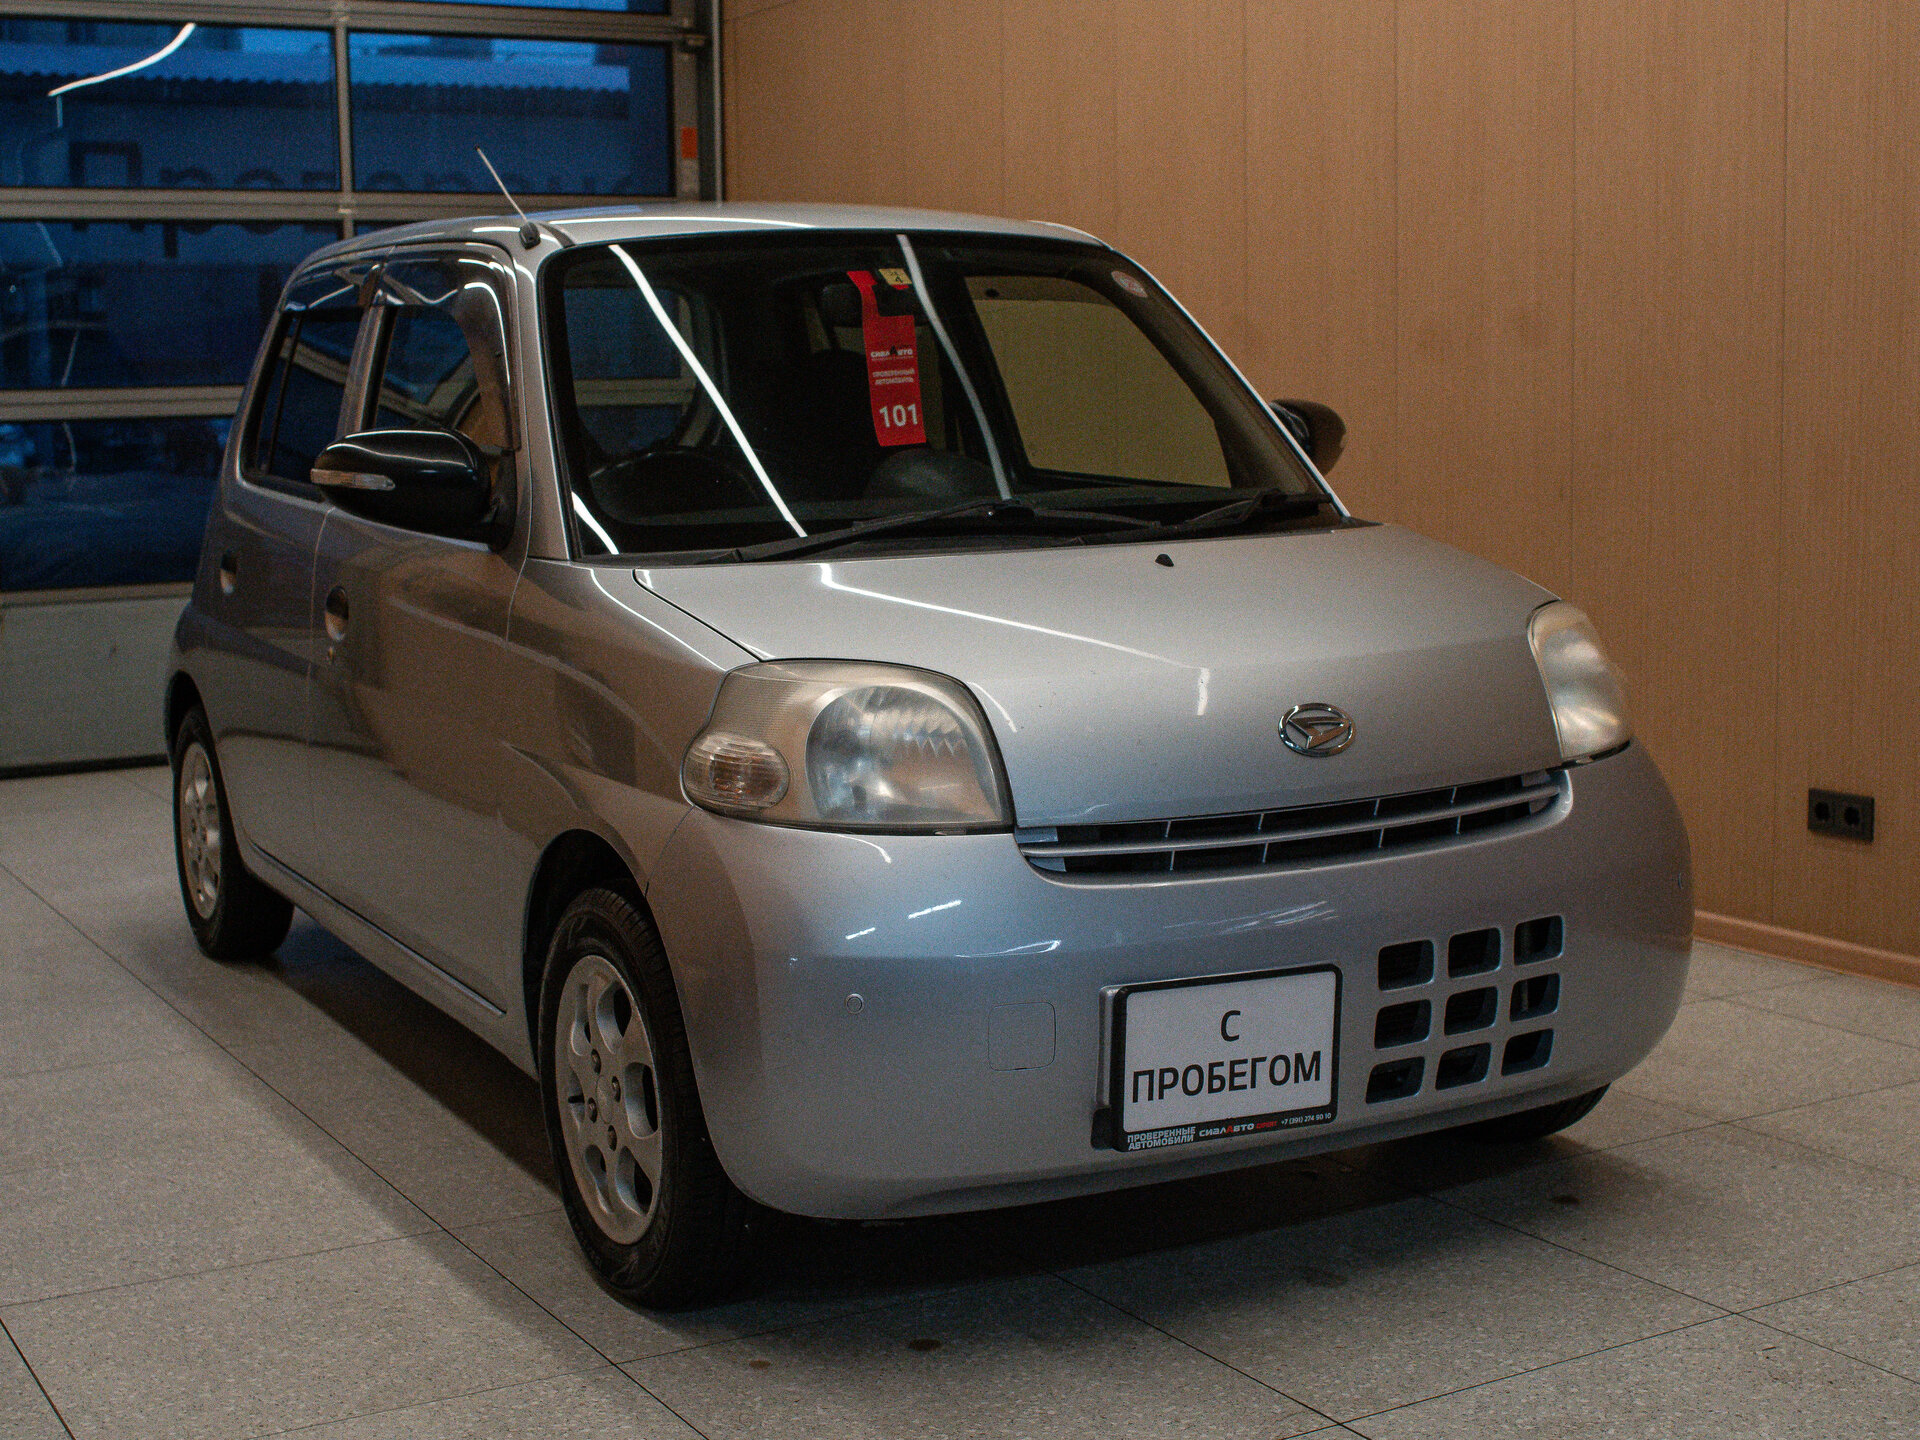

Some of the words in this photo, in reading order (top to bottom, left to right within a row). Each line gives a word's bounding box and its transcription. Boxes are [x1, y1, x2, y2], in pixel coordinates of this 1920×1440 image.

[879, 403, 918, 428] 101
[1220, 1009, 1241, 1042] С
[1132, 1050, 1322, 1103] ПРОБЕГОМ
[1127, 1126, 1196, 1143] ПРОВЕРЕННЫЕ
[1127, 1134, 1194, 1151] АВТОМОБИЛИ
